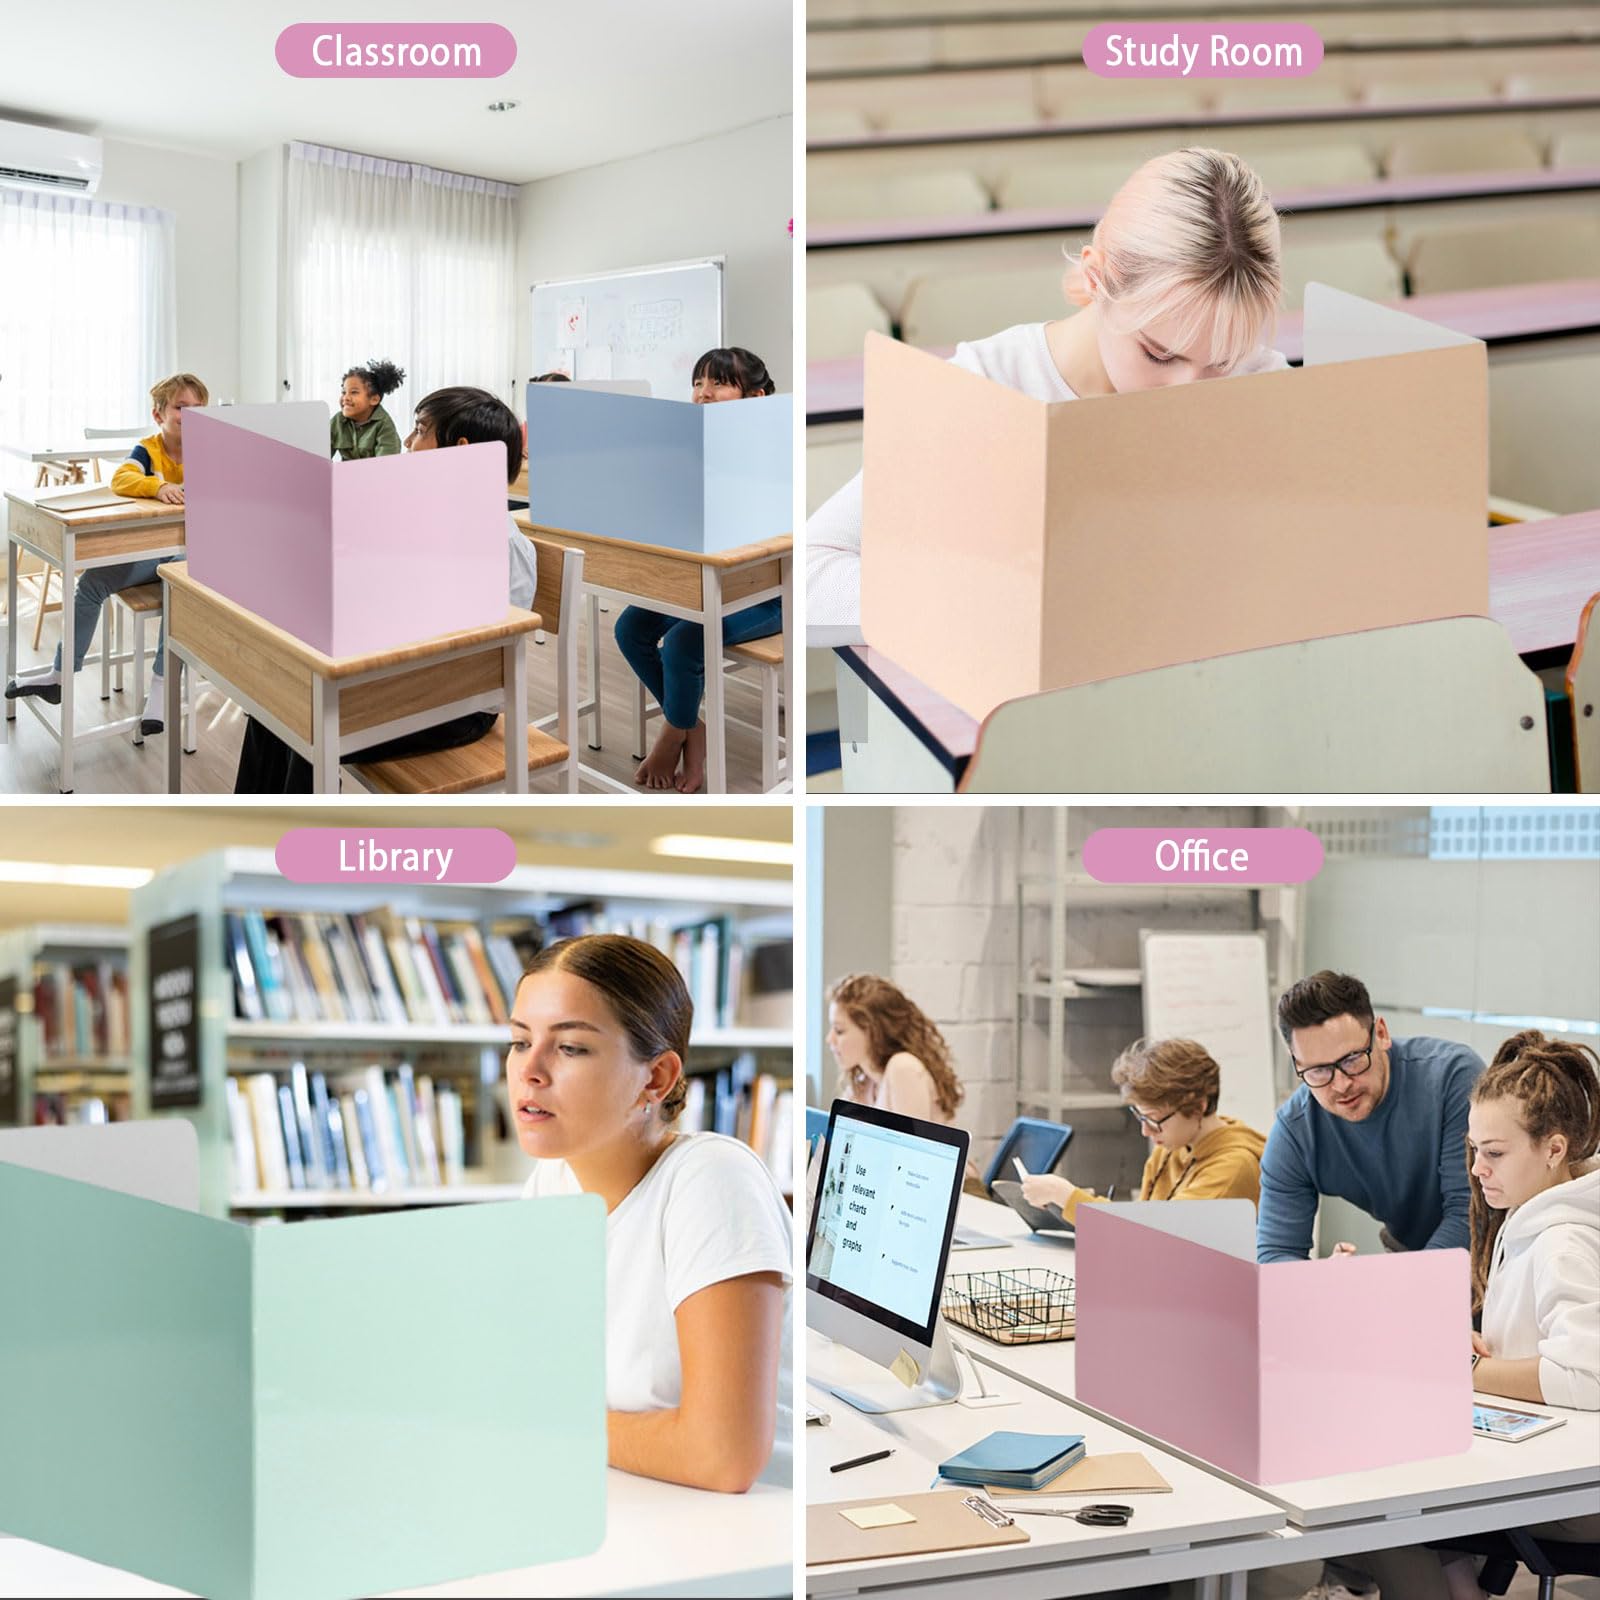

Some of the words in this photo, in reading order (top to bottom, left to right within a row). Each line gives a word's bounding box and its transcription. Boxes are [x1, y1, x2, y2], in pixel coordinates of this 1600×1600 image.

[856, 1163, 867, 1176] Use
[852, 1184, 876, 1200] relevant
[849, 1201, 867, 1215] charts
[845, 1220, 858, 1231] and
[842, 1238, 862, 1252] graphs
